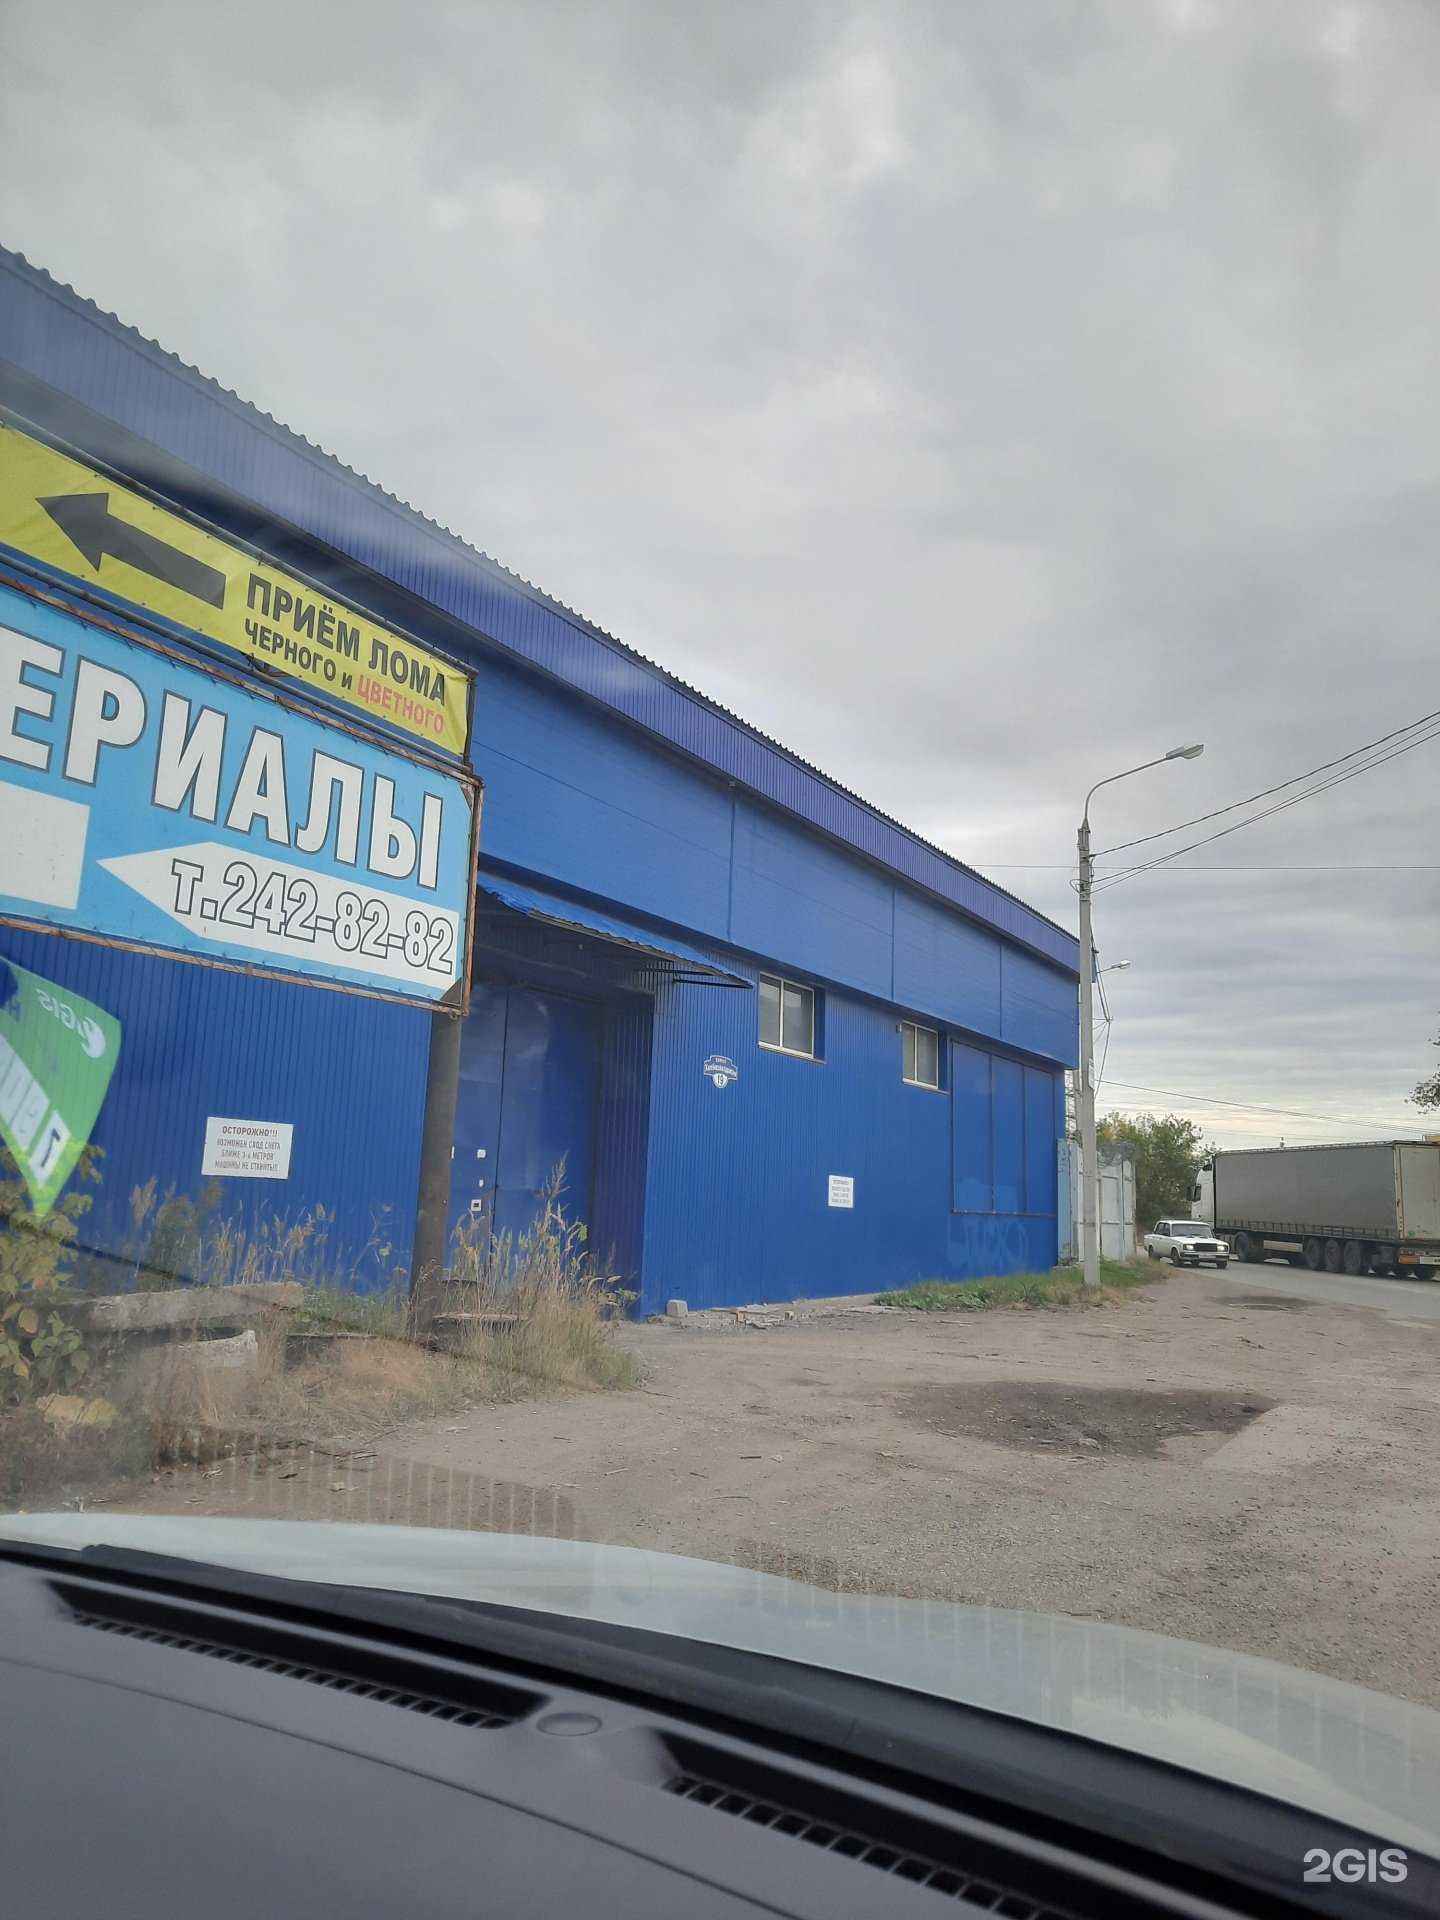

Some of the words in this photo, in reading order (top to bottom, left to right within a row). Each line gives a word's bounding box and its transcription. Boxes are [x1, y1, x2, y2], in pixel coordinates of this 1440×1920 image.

[245, 618, 336, 682] ЧЕРНОГО
[356, 674, 445, 734] ЦВЕТНОГО
[247, 573, 360, 662] ПРИЁМ
[368, 638, 446, 706] ЛОМА
[0, 622, 444, 892] ЕРИАЛЫ
